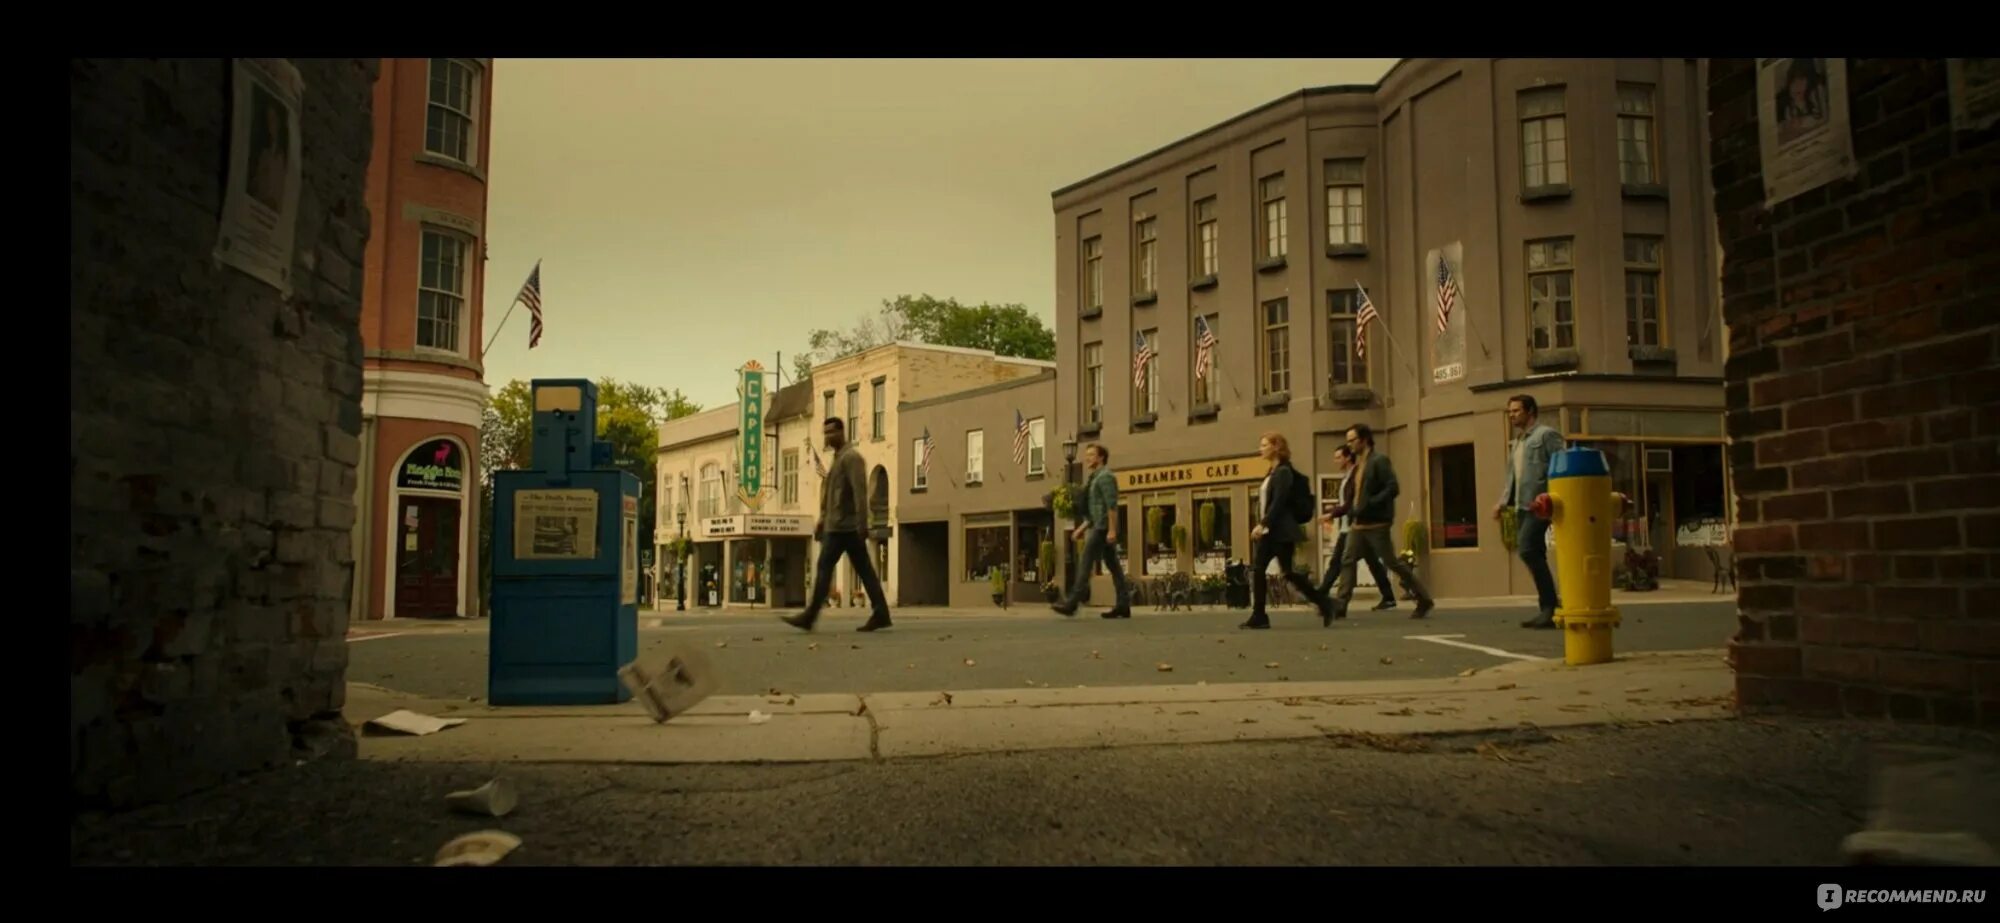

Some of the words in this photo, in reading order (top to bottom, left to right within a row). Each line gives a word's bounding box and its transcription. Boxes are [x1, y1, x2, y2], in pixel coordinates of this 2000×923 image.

[747, 380, 760, 495] CAPITOL
[1129, 468, 1193, 486] DREAMERS
[1206, 464, 1240, 478] CAFE
